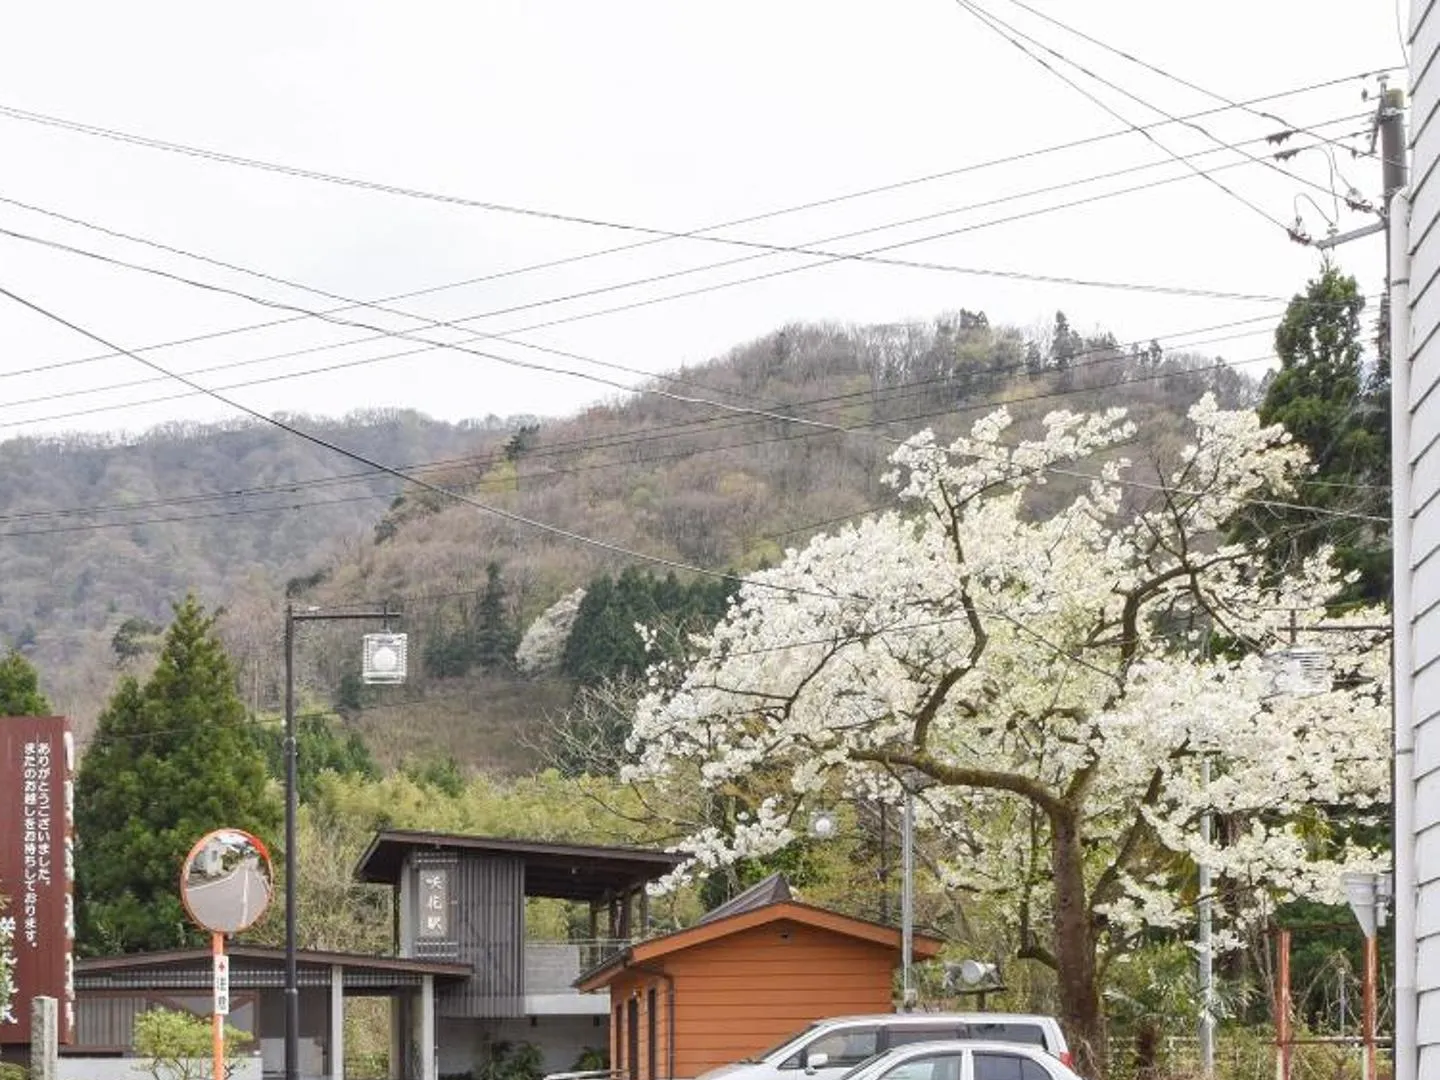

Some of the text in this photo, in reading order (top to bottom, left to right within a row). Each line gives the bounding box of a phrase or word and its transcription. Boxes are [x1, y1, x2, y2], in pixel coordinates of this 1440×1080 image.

[38, 742, 51, 886] ありがとうございました。
